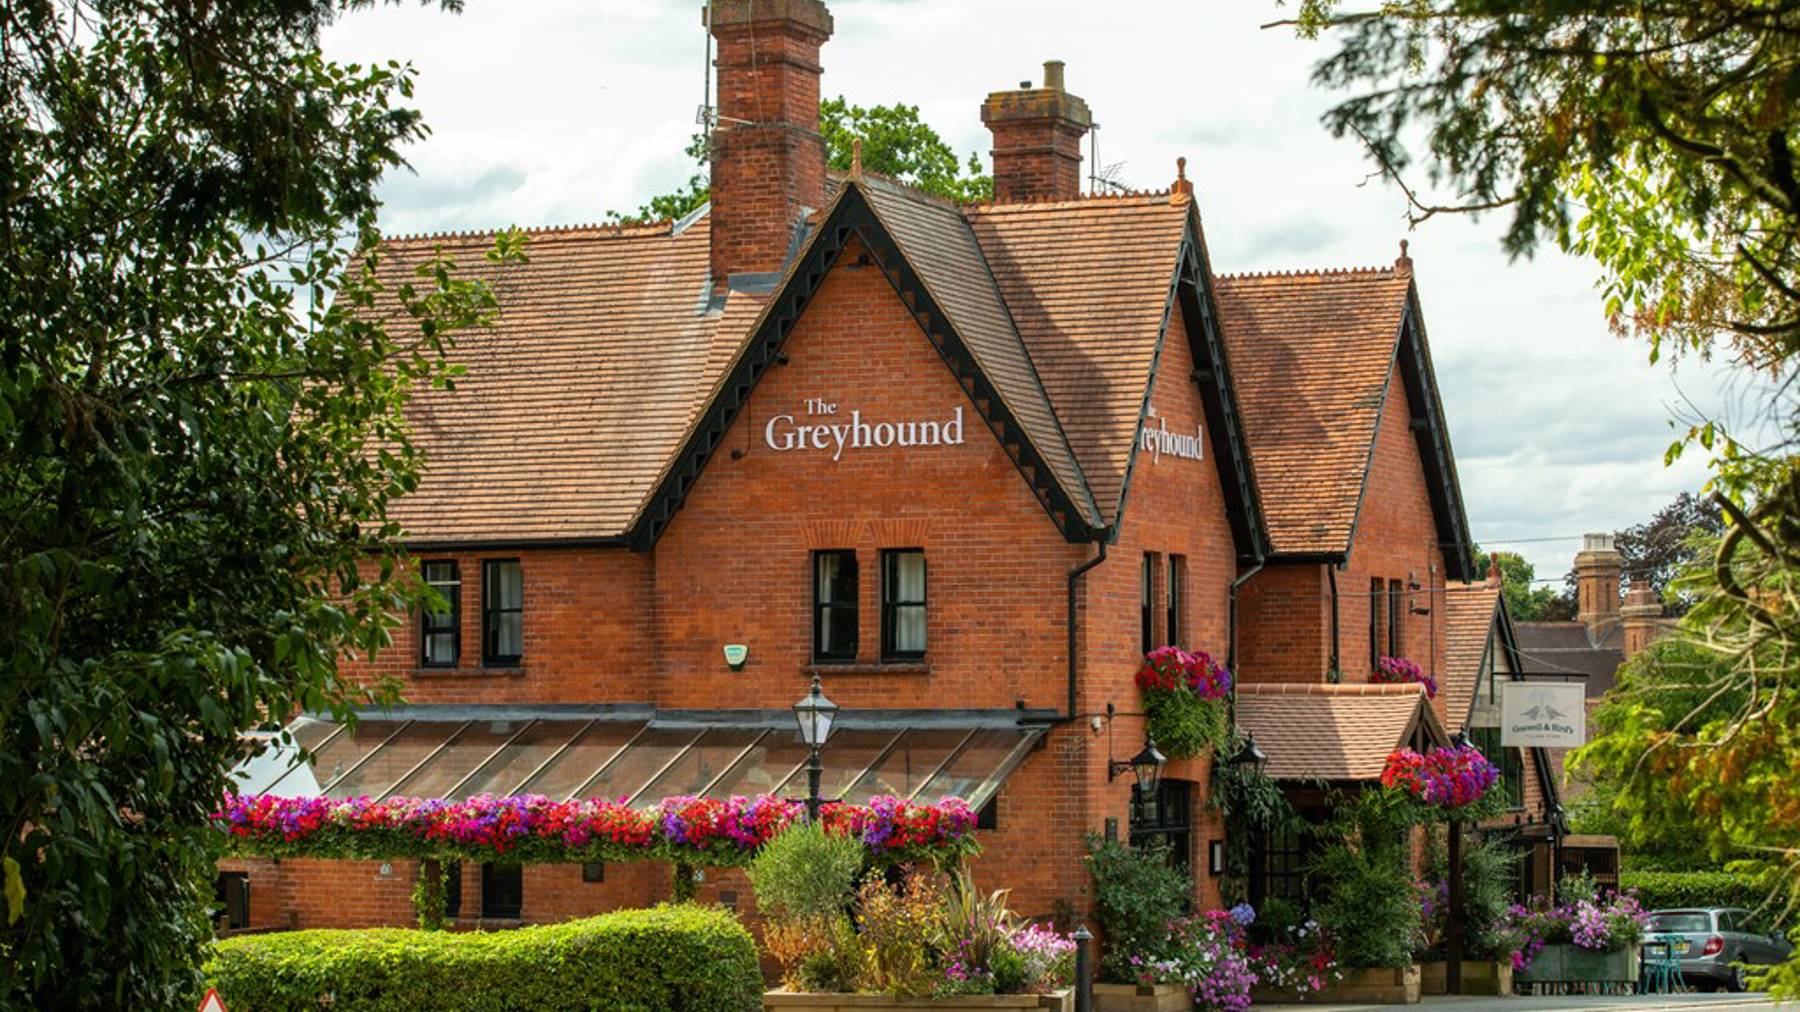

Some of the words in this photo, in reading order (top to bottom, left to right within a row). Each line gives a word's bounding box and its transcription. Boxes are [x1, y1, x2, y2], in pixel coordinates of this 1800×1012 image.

[804, 398, 837, 415] The
[765, 406, 965, 461] Greyhound
[1140, 416, 1204, 465] reyhound
